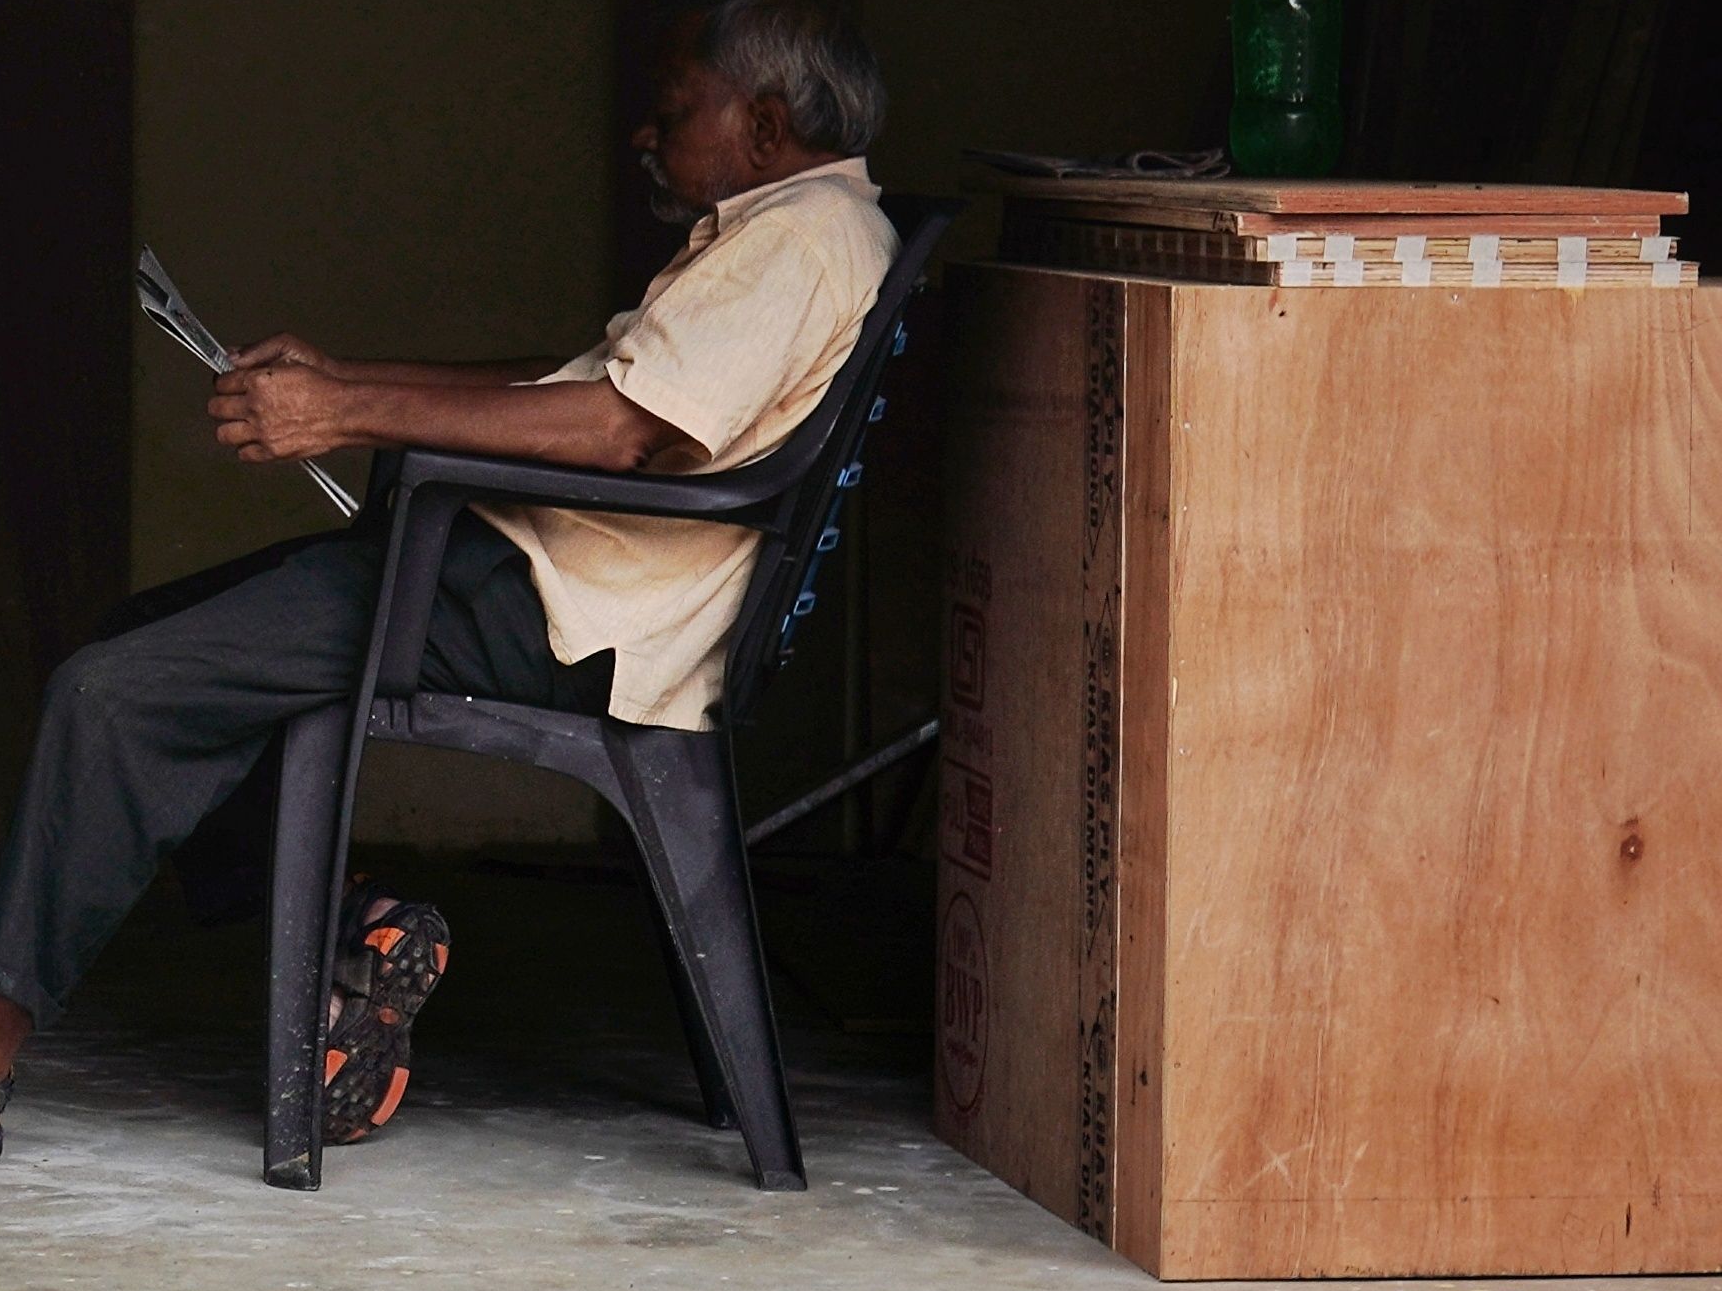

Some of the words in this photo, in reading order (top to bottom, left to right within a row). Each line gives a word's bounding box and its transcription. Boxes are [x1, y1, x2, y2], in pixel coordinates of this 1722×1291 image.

[1087, 660, 1098, 752] KHAS
[1100, 689, 1112, 805] KHAS
[1086, 765, 1097, 931] DIAMOND
[1099, 820, 1110, 899] PLY
[1081, 1060, 1092, 1151] KHAS
